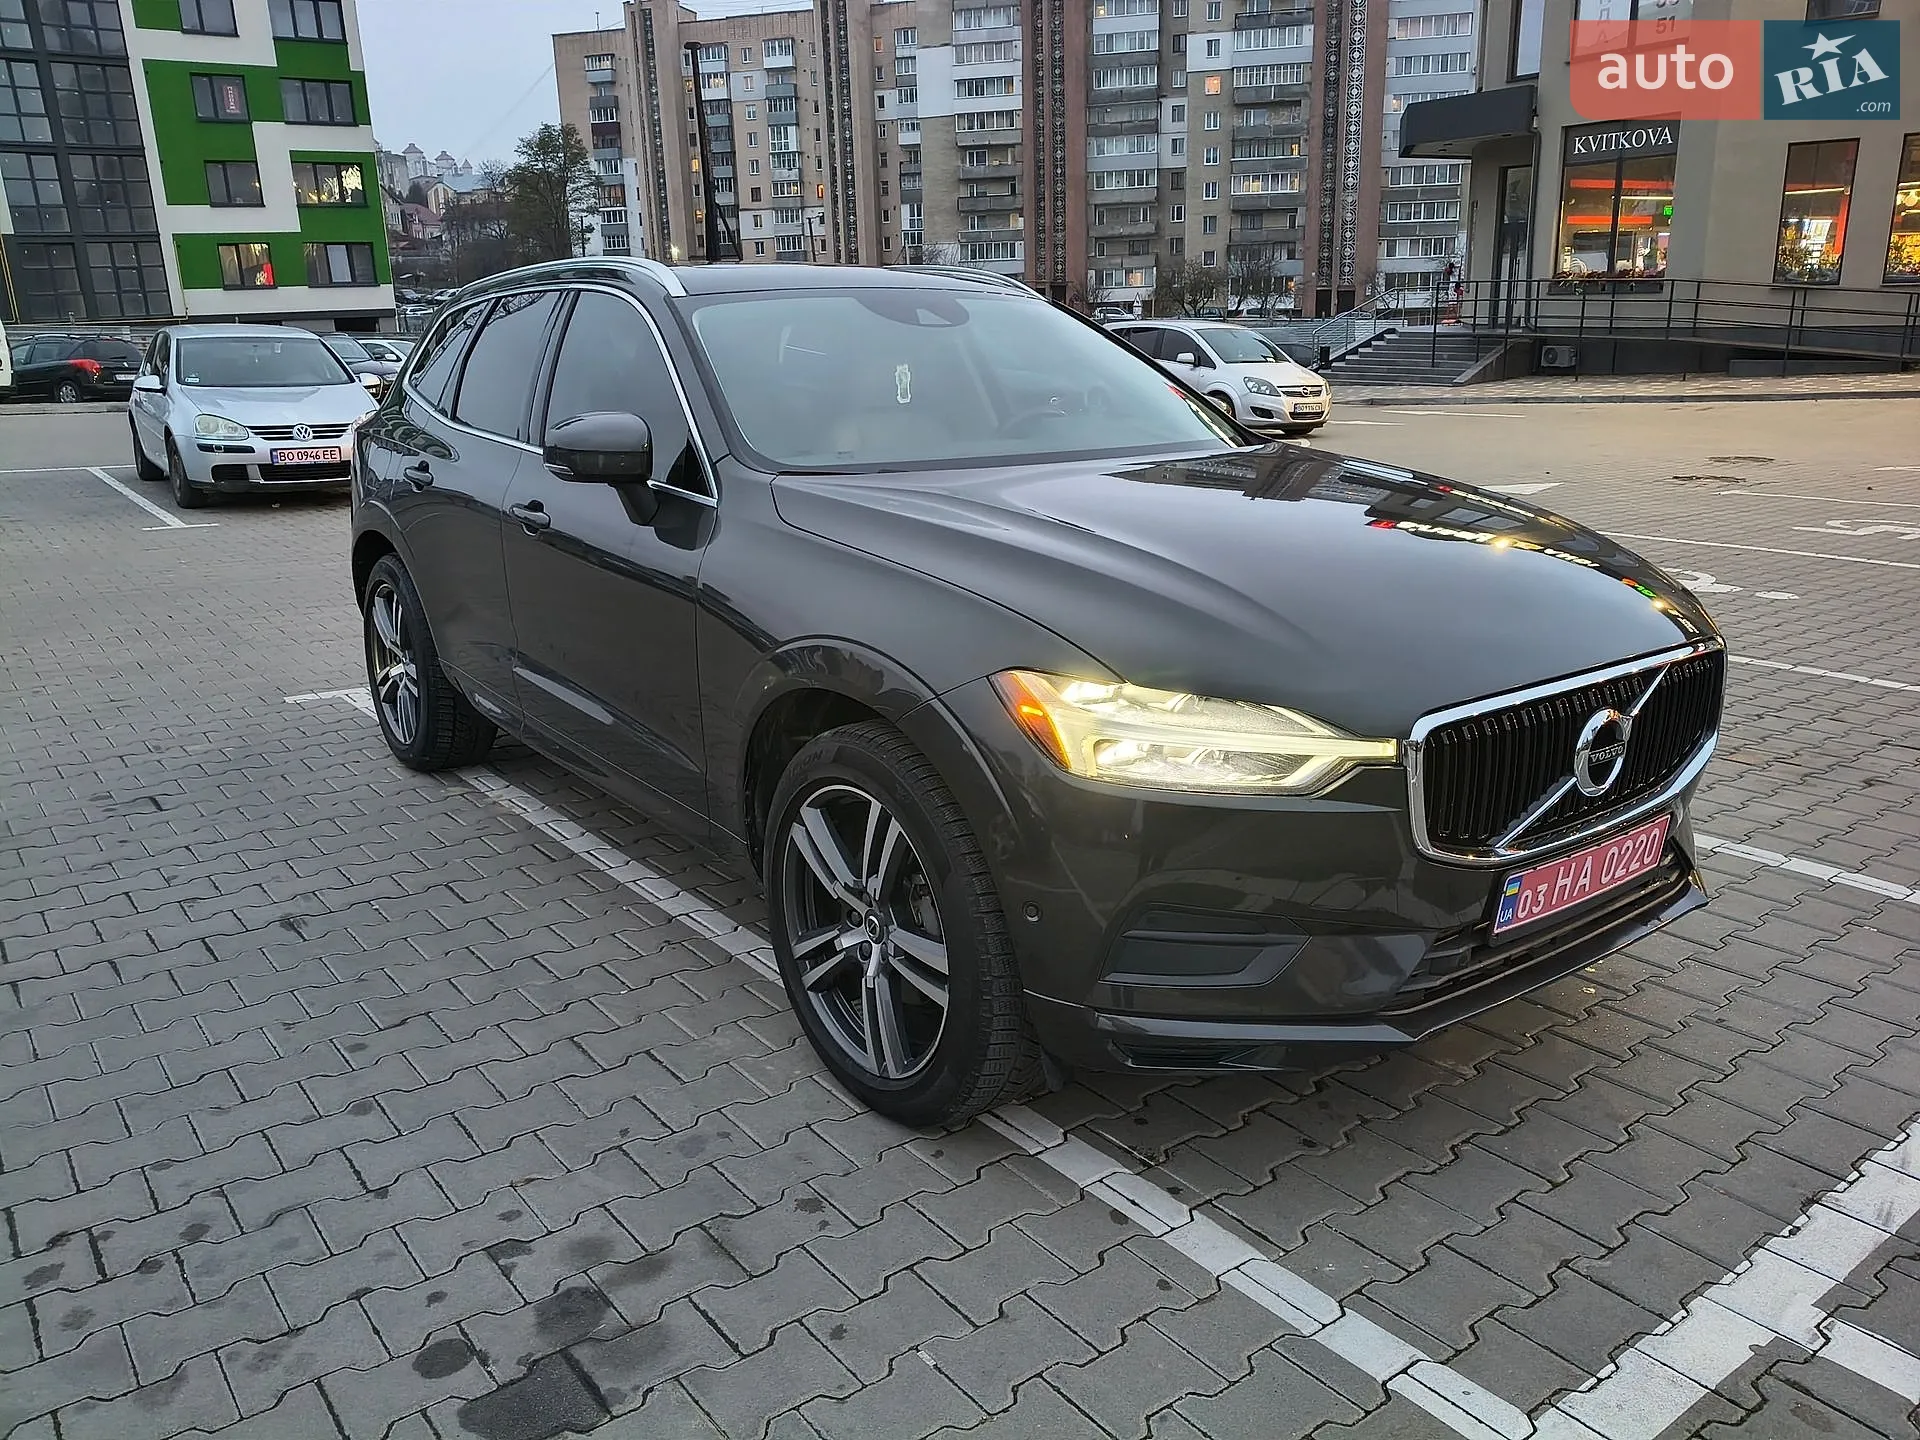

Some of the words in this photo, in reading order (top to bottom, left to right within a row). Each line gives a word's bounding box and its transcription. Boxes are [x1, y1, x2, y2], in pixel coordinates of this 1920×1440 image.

[1656, 16, 1676, 34] 51
[1573, 126, 1673, 154] KVITKOVA
[279, 452, 295, 462] BO
[297, 450, 320, 460] 0946
[322, 450, 337, 459] EE
[1590, 746, 1624, 762] VOLVO
[1517, 883, 1548, 918] 03
[1551, 856, 1593, 905] HA
[1601, 828, 1660, 884] 0220
[1500, 907, 1513, 922] UA
